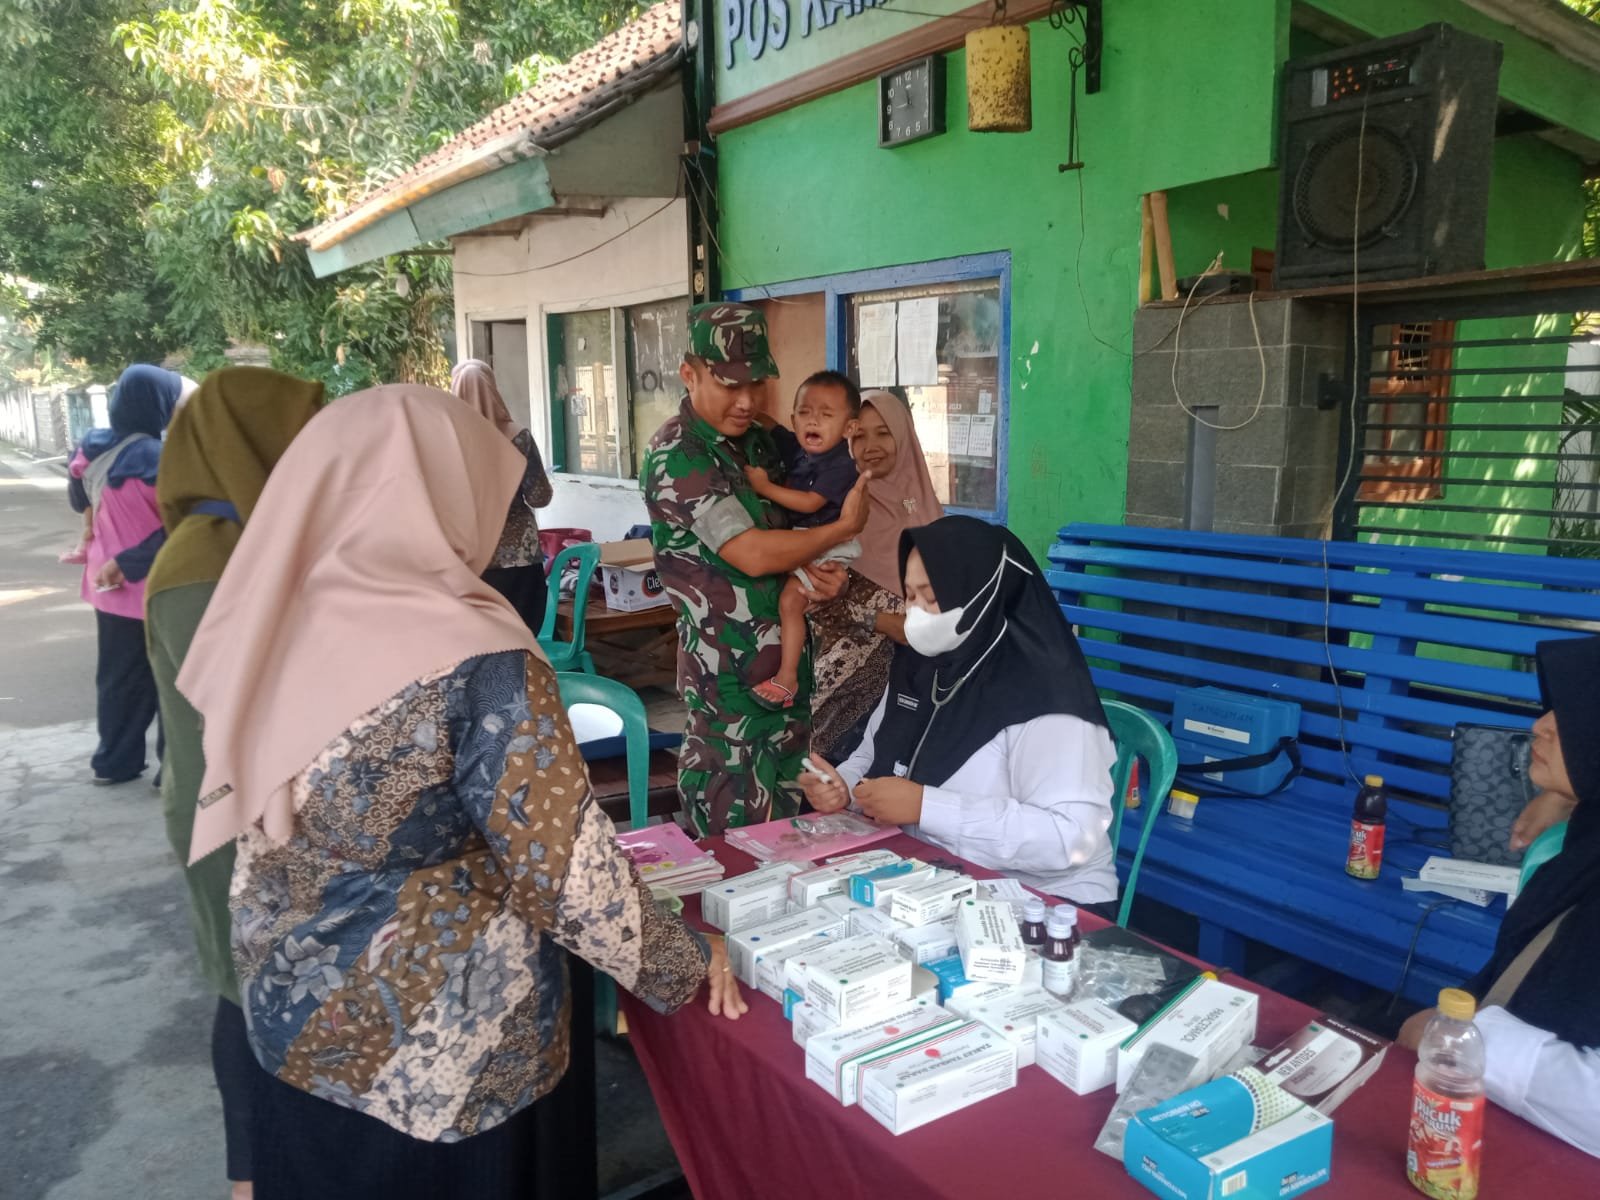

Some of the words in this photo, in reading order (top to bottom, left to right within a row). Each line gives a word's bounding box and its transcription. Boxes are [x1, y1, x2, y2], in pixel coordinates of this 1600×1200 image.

[725, 0, 790, 70] POS
[896, 75, 902, 87] 11
[904, 70, 912, 81] 12
[887, 87, 895, 99] 10
[886, 104, 892, 115] 9
[905, 126, 911, 137] 6
[915, 121, 921, 132] 5
